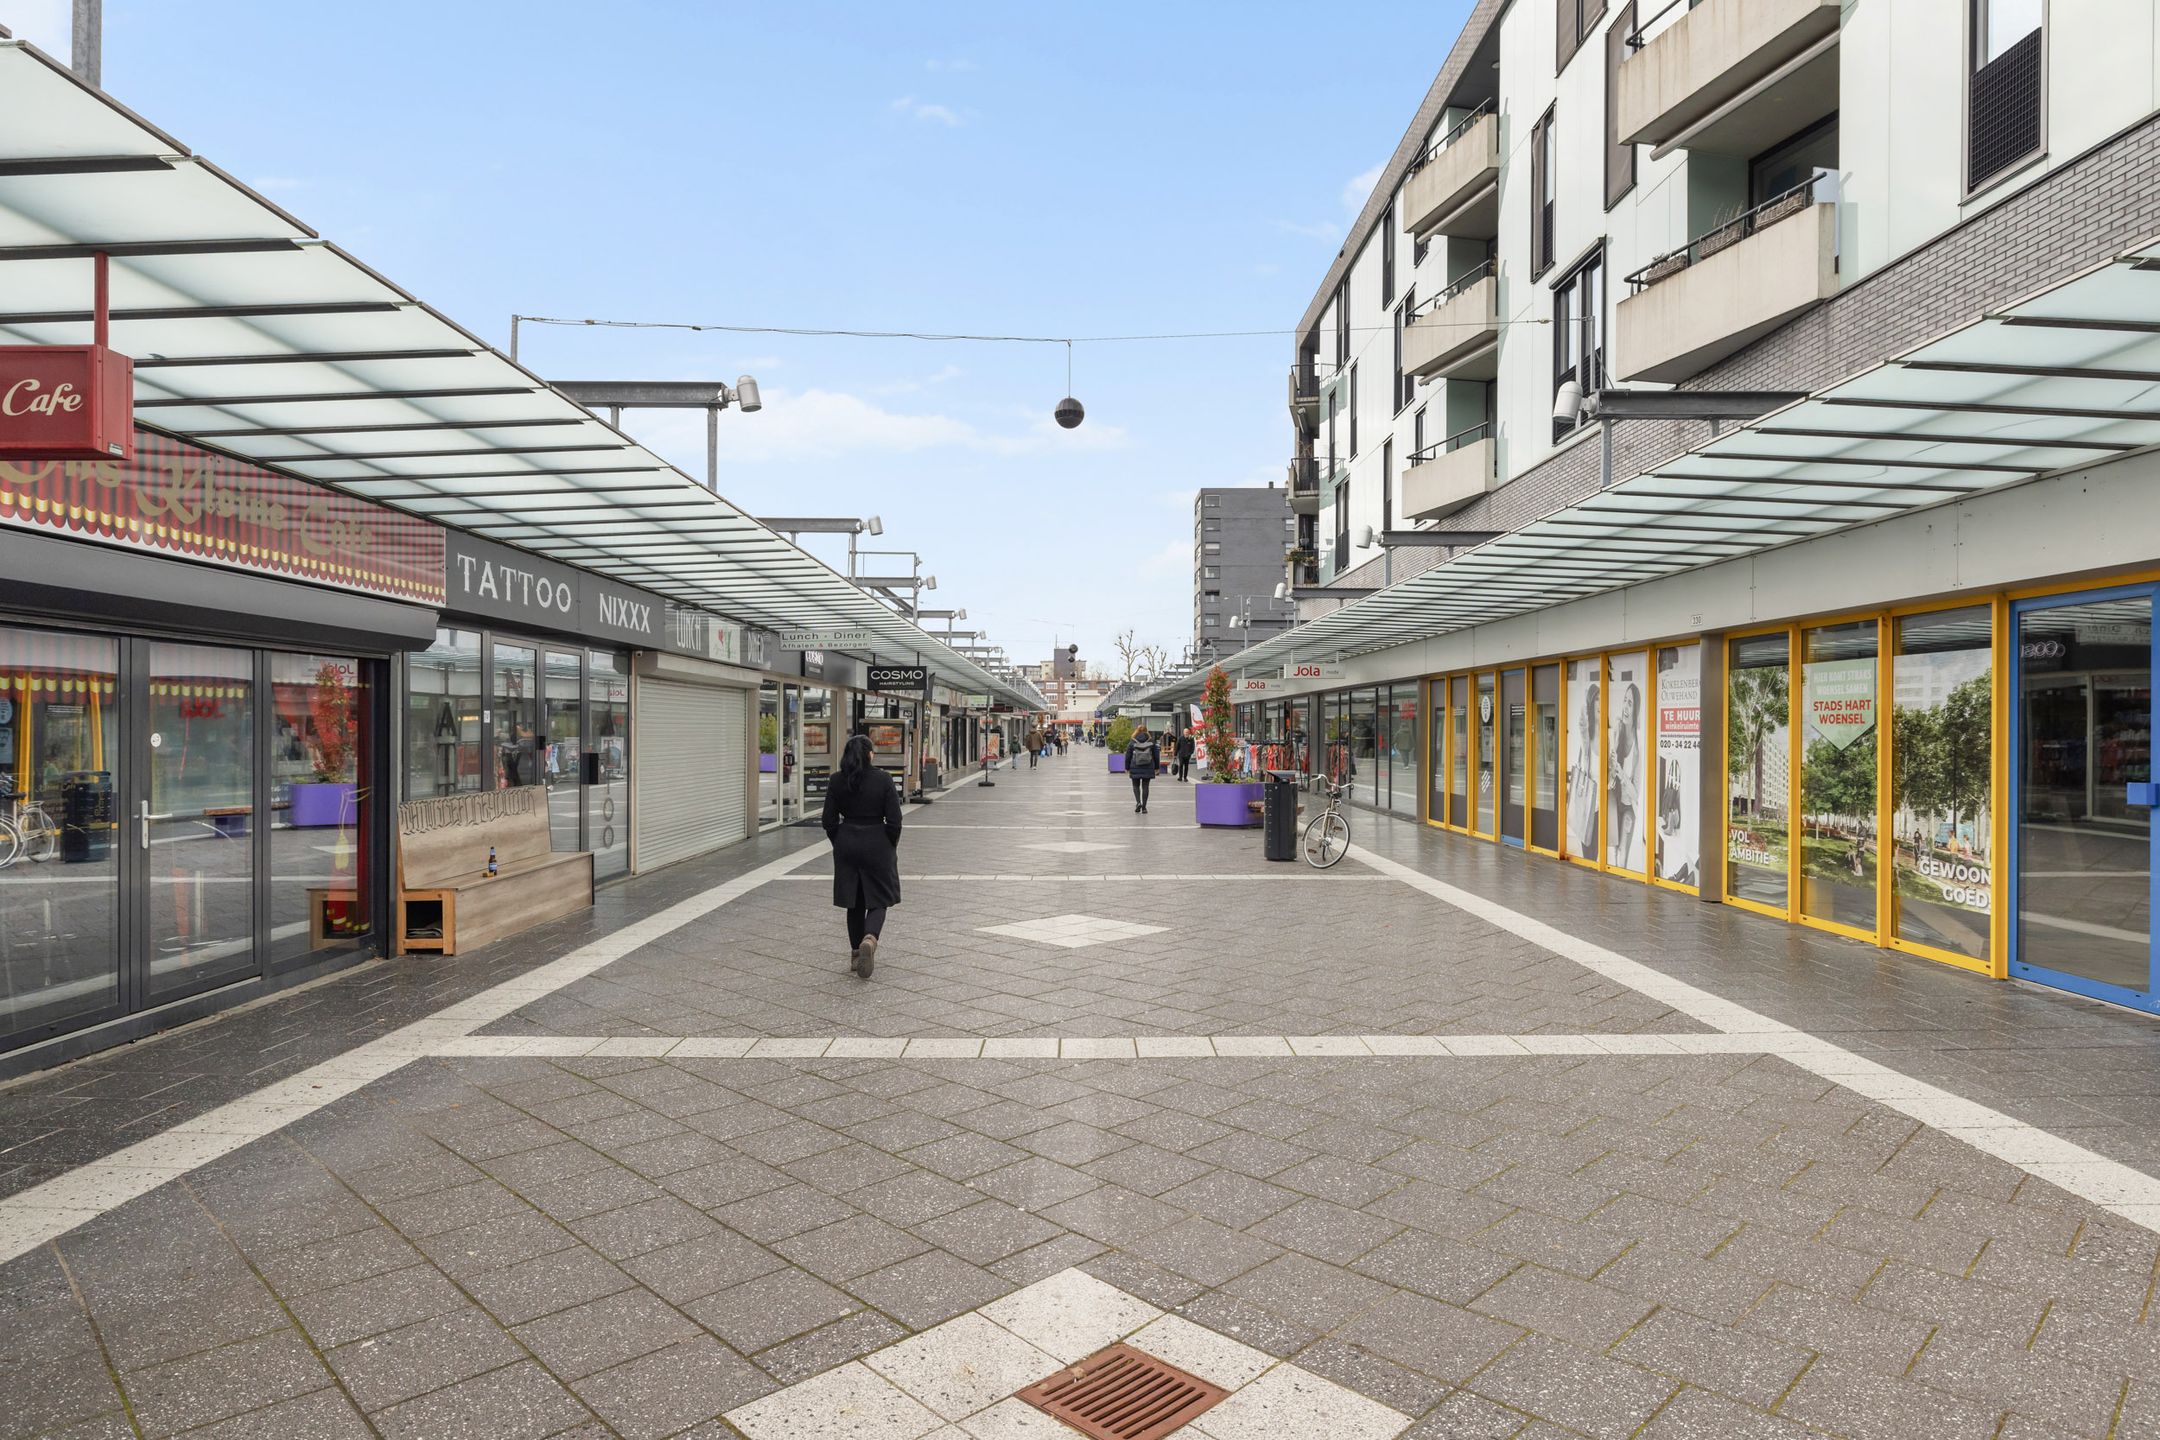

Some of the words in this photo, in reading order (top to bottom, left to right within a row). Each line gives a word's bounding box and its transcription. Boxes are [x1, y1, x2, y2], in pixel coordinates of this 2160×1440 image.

[2, 379, 83, 416] Cafe
[136, 462, 287, 531] Kleine
[457, 553, 572, 613] TATTOO
[600, 593, 651, 634] NIXXX
[676, 609, 701, 652] LUNCH
[782, 632, 819, 640] Lunch
[834, 631, 867, 639] Diner
[870, 670, 924, 680] COSMO
[1293, 665, 1320, 677] Jola
[1245, 681, 1266, 690] Jola
[1661, 678, 1700, 690] KOKELENBER
[1813, 700, 1843, 711] STADS
[1845, 699, 1872, 711] HART
[1663, 710, 1674, 721] TE
[1676, 709, 1700, 721] HUUR
[1819, 713, 1865, 725] WOENSEL
[1730, 829, 1750, 843] VOL
[1730, 847, 1769, 865] AMBITIE
[1919, 858, 1991, 885] GEWOON
